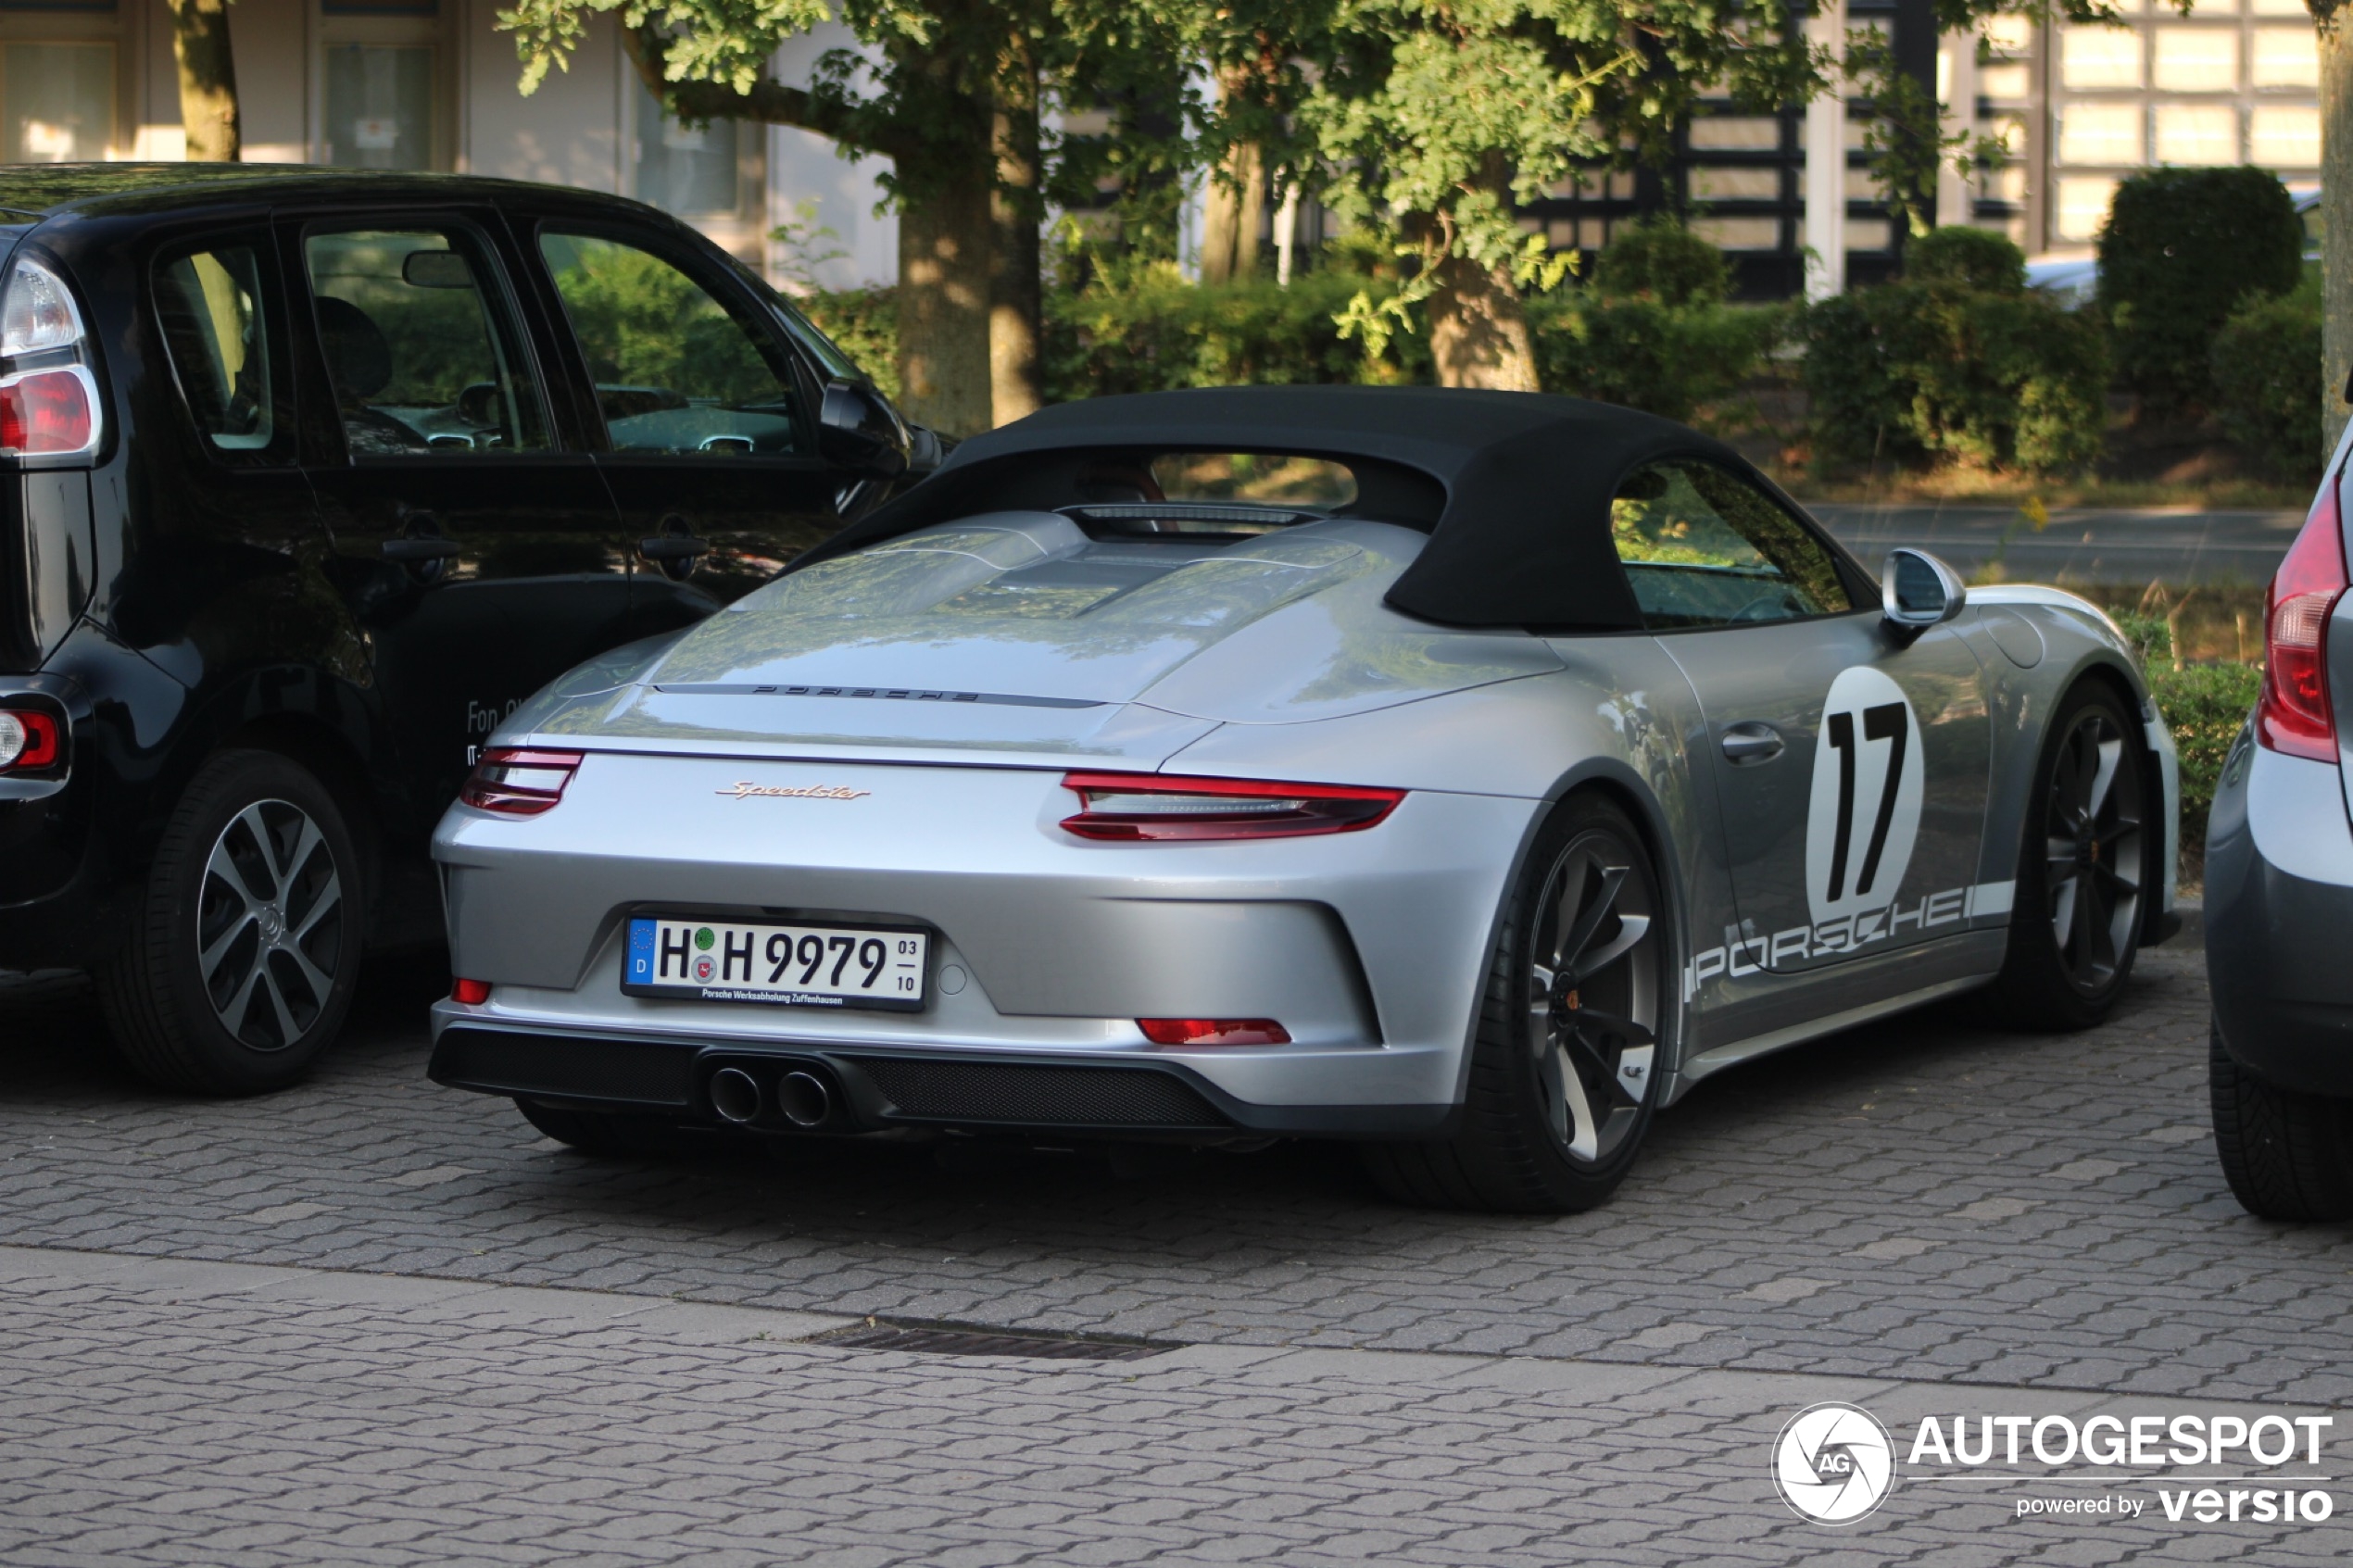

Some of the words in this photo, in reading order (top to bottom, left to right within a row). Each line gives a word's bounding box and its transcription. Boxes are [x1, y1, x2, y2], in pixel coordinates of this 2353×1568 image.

[752, 685, 979, 702] PORSCHE
[467, 701, 497, 733] Fon
[715, 781, 871, 799] Speedster
[1827, 701, 1907, 903] 17
[898, 940, 916, 955] 03
[1689, 887, 1964, 991] PORSCHE
[636, 960, 646, 973] D
[660, 927, 691, 978] H
[723, 931, 754, 982] H
[765, 934, 887, 988] 9979
[897, 976, 914, 991] 10
[701, 987, 733, 999] Porsche
[733, 990, 791, 1004] Werksabholung
[792, 993, 843, 1005] Zuffenhausen
